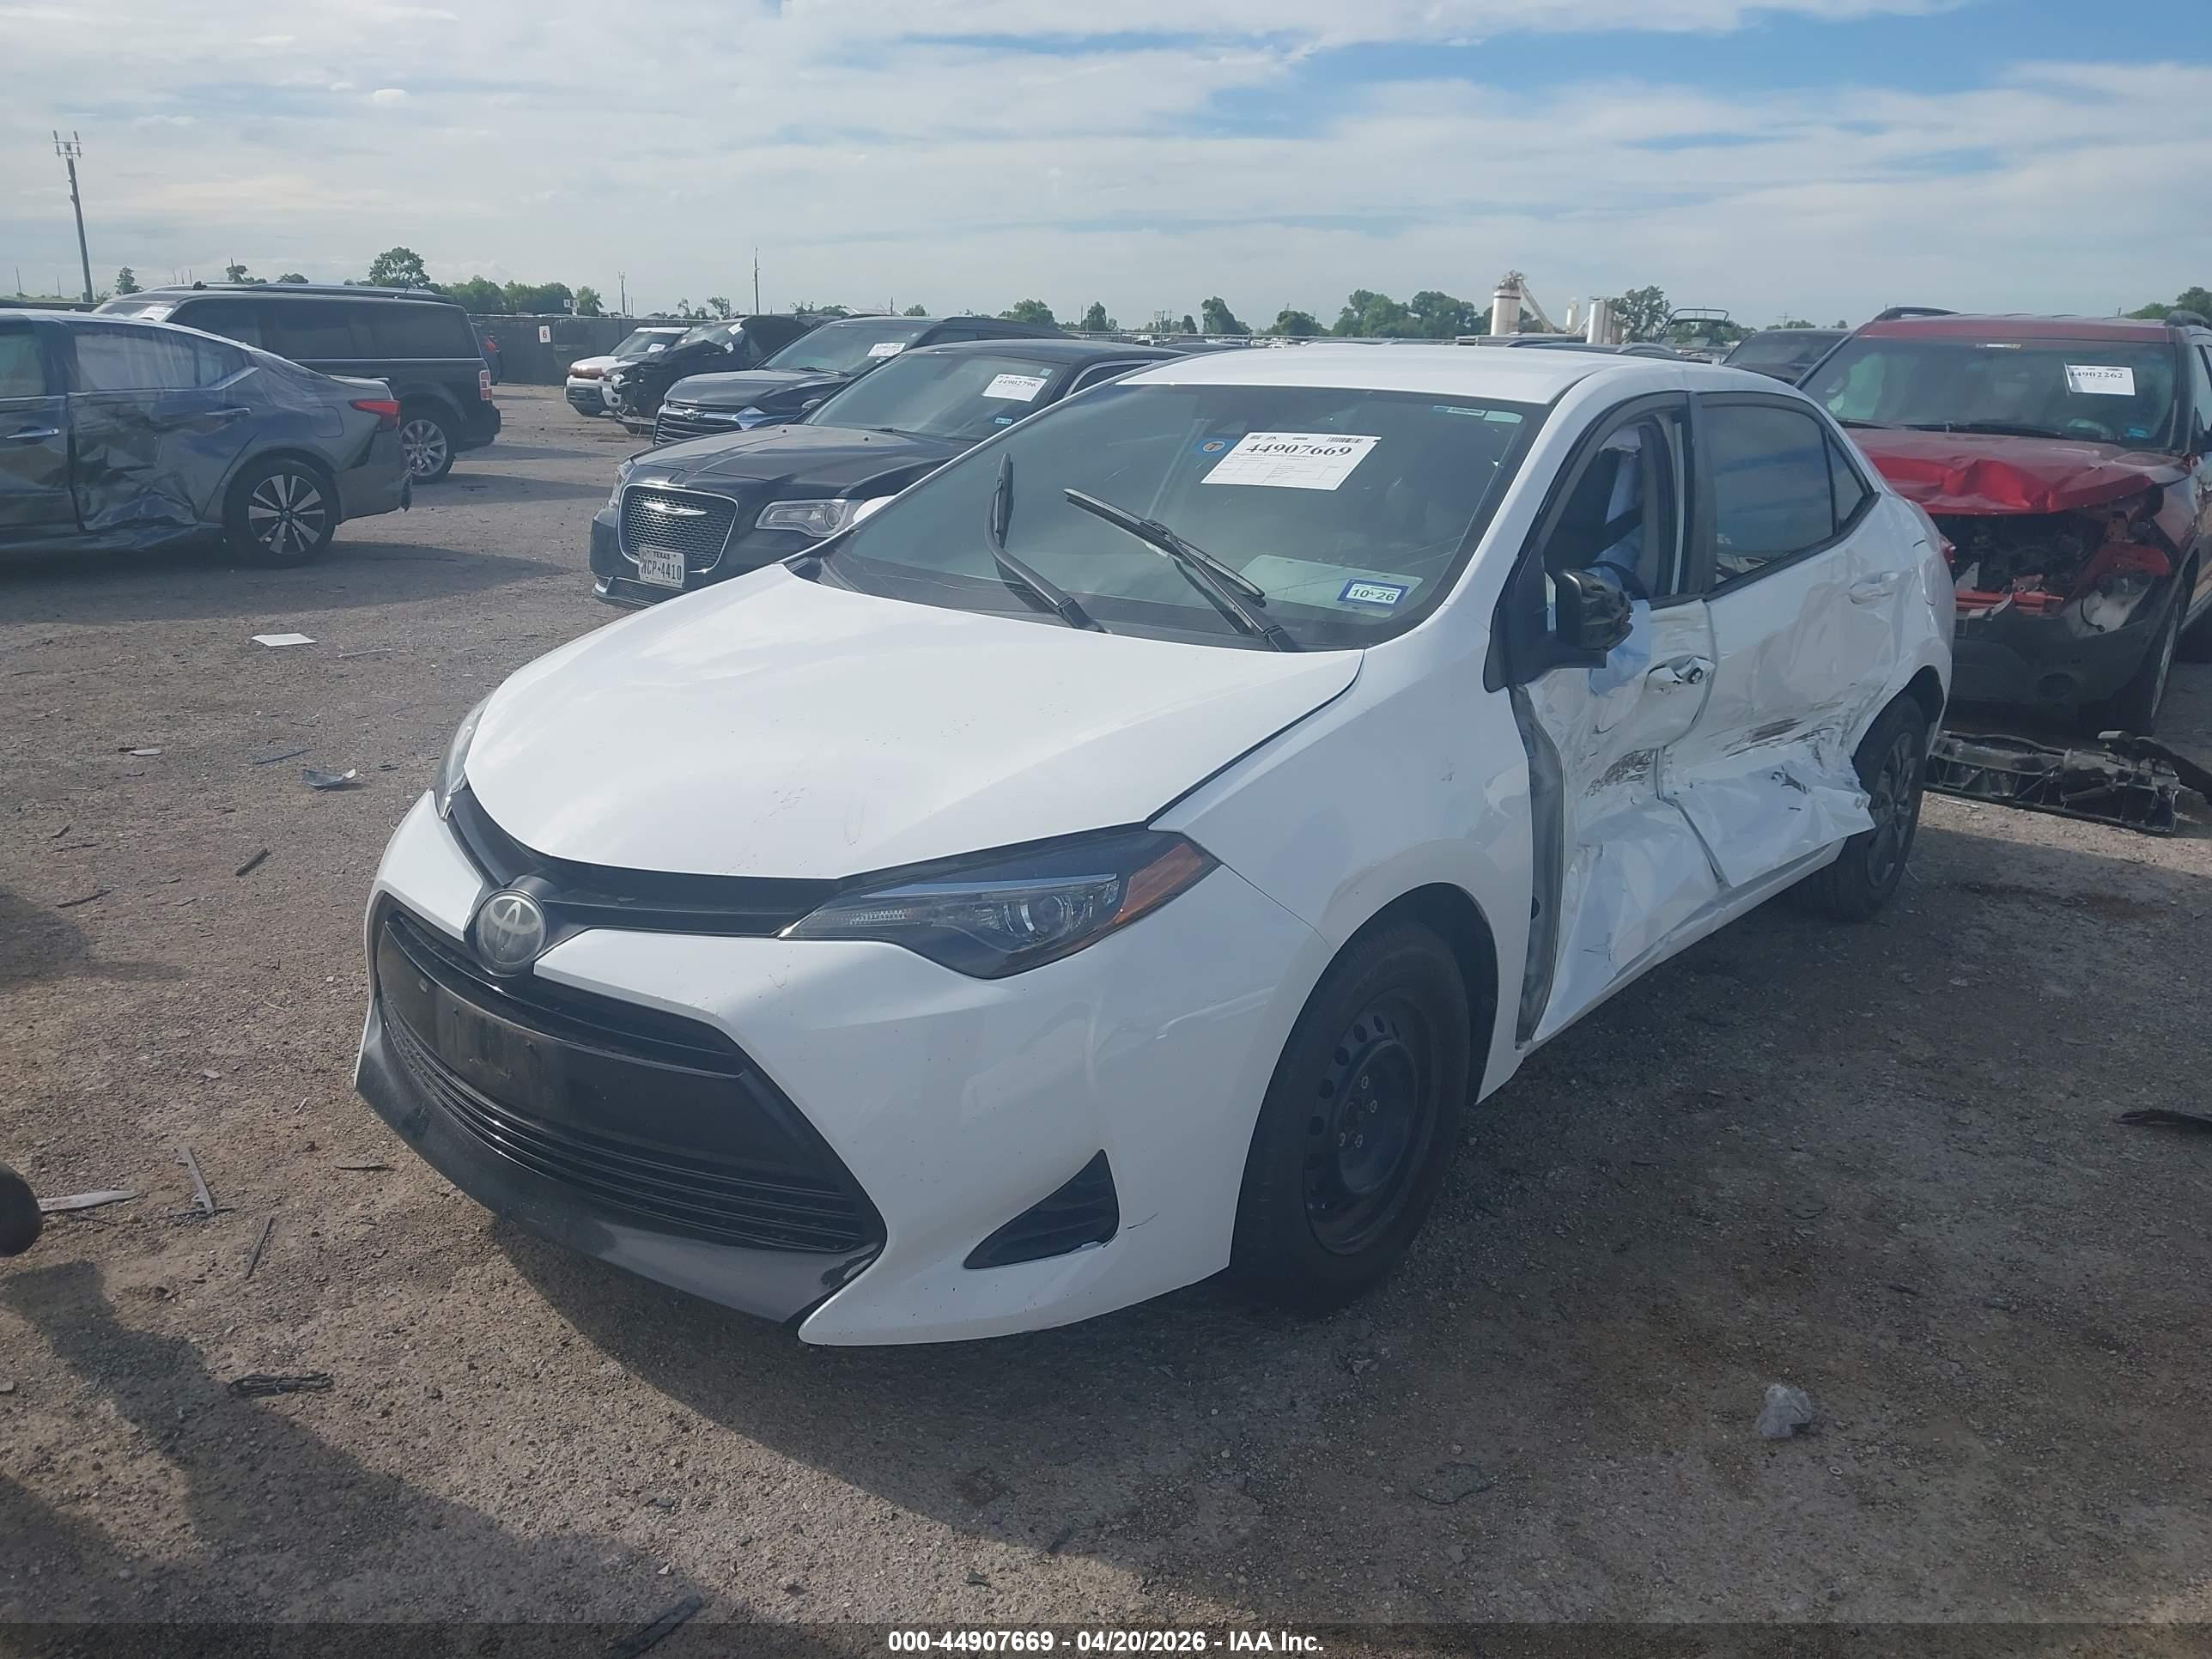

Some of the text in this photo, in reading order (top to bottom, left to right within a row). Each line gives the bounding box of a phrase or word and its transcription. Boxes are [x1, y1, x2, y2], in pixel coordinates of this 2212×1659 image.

[543, 330, 548, 338] 6
[1245, 442, 1352, 457] 44907669
[653, 550, 671, 560] TEXAS
